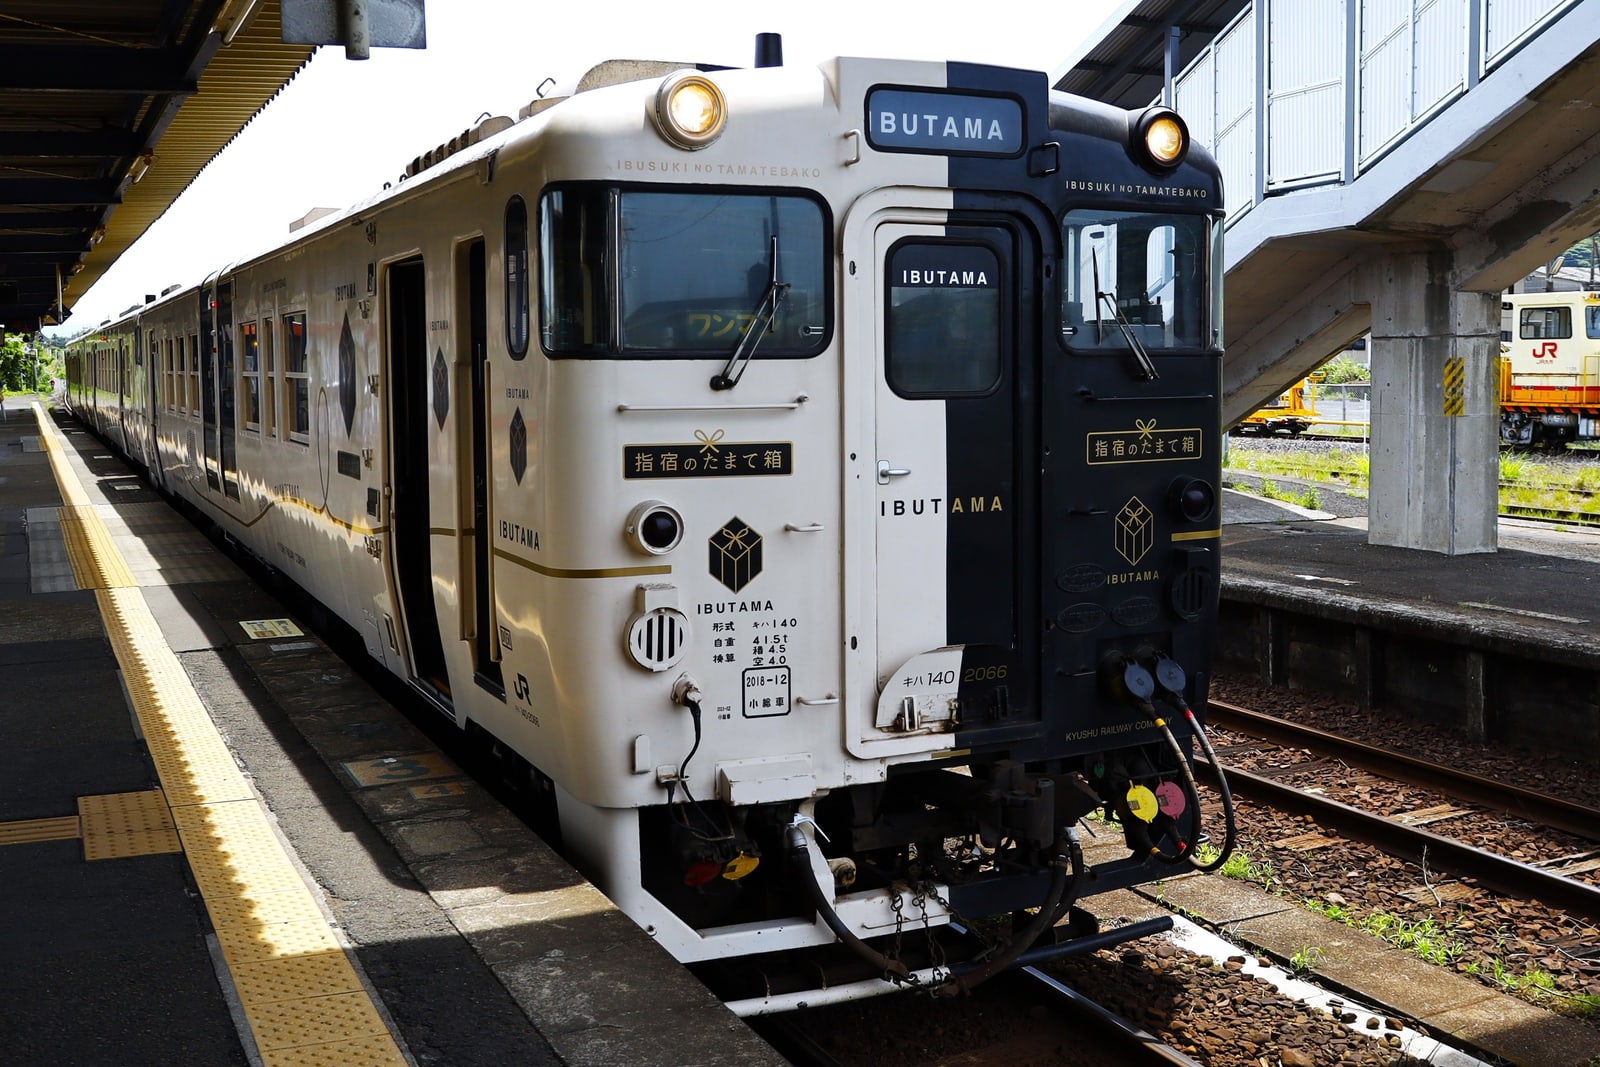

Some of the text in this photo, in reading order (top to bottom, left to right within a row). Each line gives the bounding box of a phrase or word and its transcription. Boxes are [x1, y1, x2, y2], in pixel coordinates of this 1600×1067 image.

[617, 160, 821, 178] IBUSUKI NO TAMATEBAKO
[1065, 180, 1207, 198] IBUSUKI NO TAMATEBAKO
[903, 270, 987, 285] IBUTAMA
[1532, 342, 1557, 358] JR
[506, 388, 529, 400] IBUTAMA
[1095, 435, 1194, 457] 指宿のたまて箱
[635, 450, 782, 473] 指宿のたまて箱
[881, 496, 1003, 516] IBUTAMA
[499, 519, 540, 551] IBUTAMA
[1107, 570, 1159, 584] IBUTAMA
[697, 600, 774, 614] IBUTAMA
[712, 621, 735, 632] 形式
[714, 637, 735, 647] 自重
[768, 644, 786, 654] 4.5
[768, 655, 787, 665] 4.0
[903, 665, 1008, 687] キハ 140 2066
[513, 672, 533, 706] JR
[1065, 716, 1173, 741] KYUSHU RAILWAY COMY
[370, 758, 430, 780] 3
